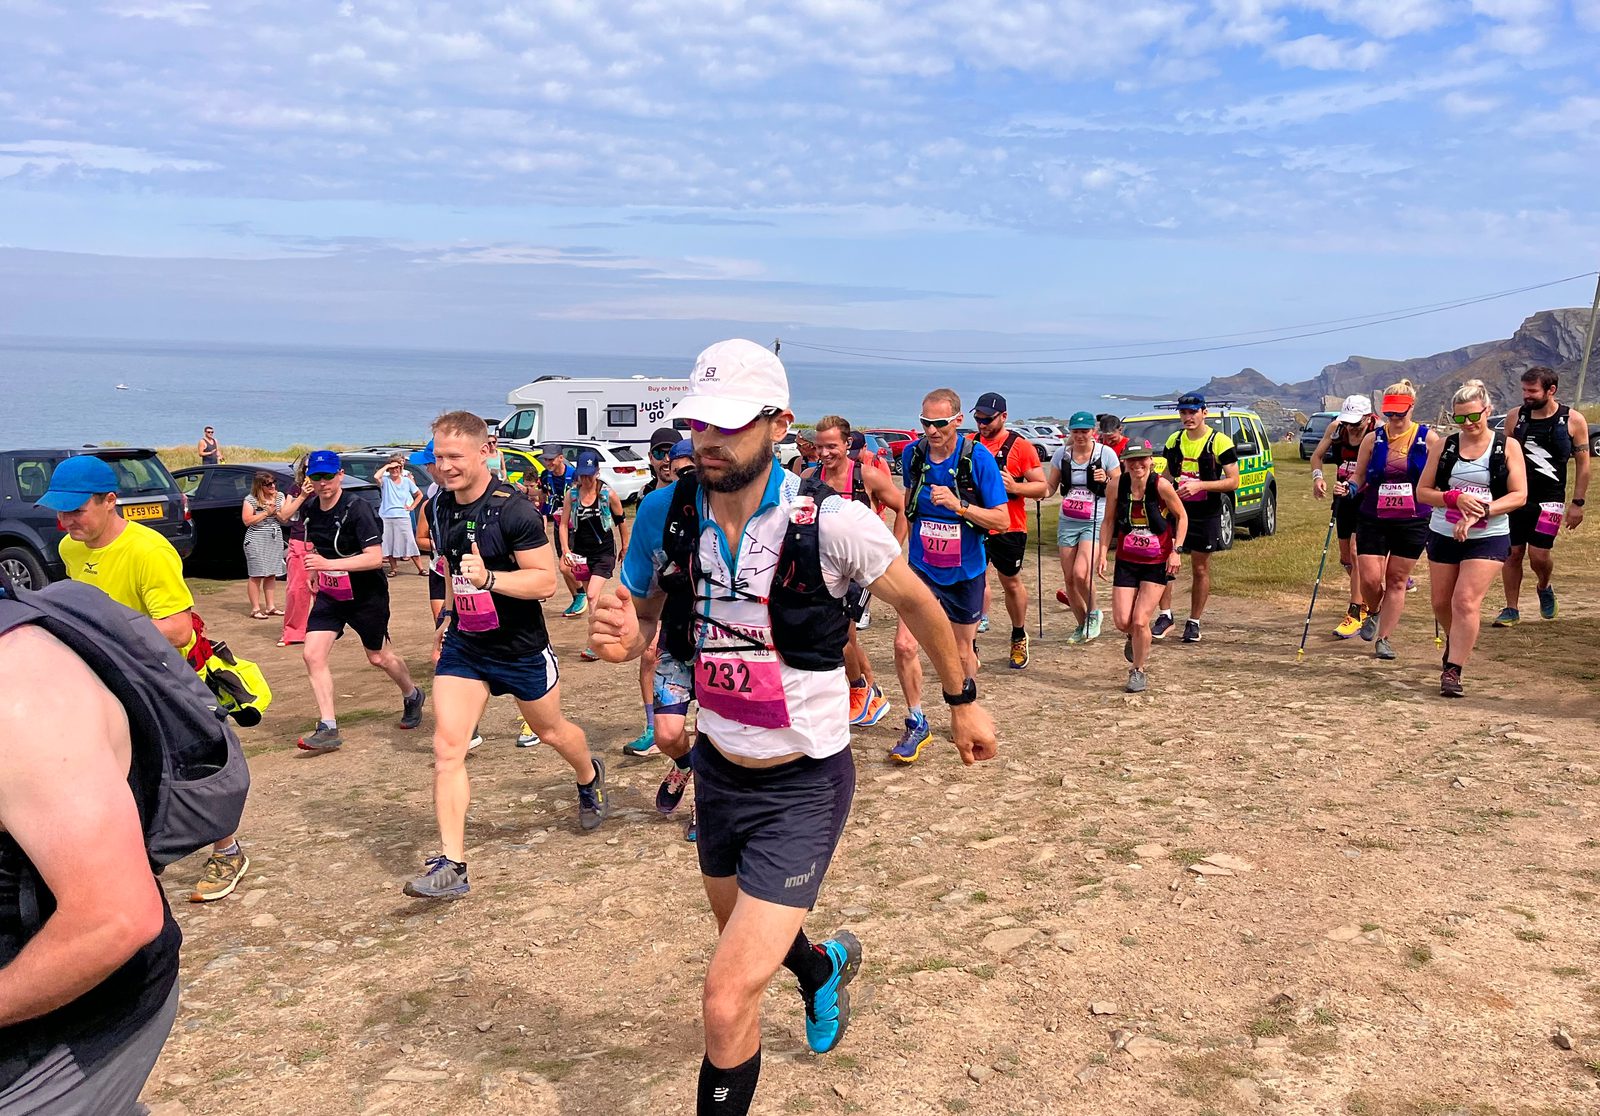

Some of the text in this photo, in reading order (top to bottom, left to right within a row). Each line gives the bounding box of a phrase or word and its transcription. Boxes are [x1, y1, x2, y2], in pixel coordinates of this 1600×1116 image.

[639, 399, 665, 412] Just
[649, 410, 665, 423] go
[1069, 500, 1084, 511] 223
[1385, 496, 1404, 507] 224
[126, 505, 160, 517] LF59 YSS
[922, 521, 958, 532] TSUNAMI
[927, 538, 949, 552] 217
[1132, 536, 1151, 548] 239
[456, 595, 477, 612] 221
[703, 660, 753, 693] 232
